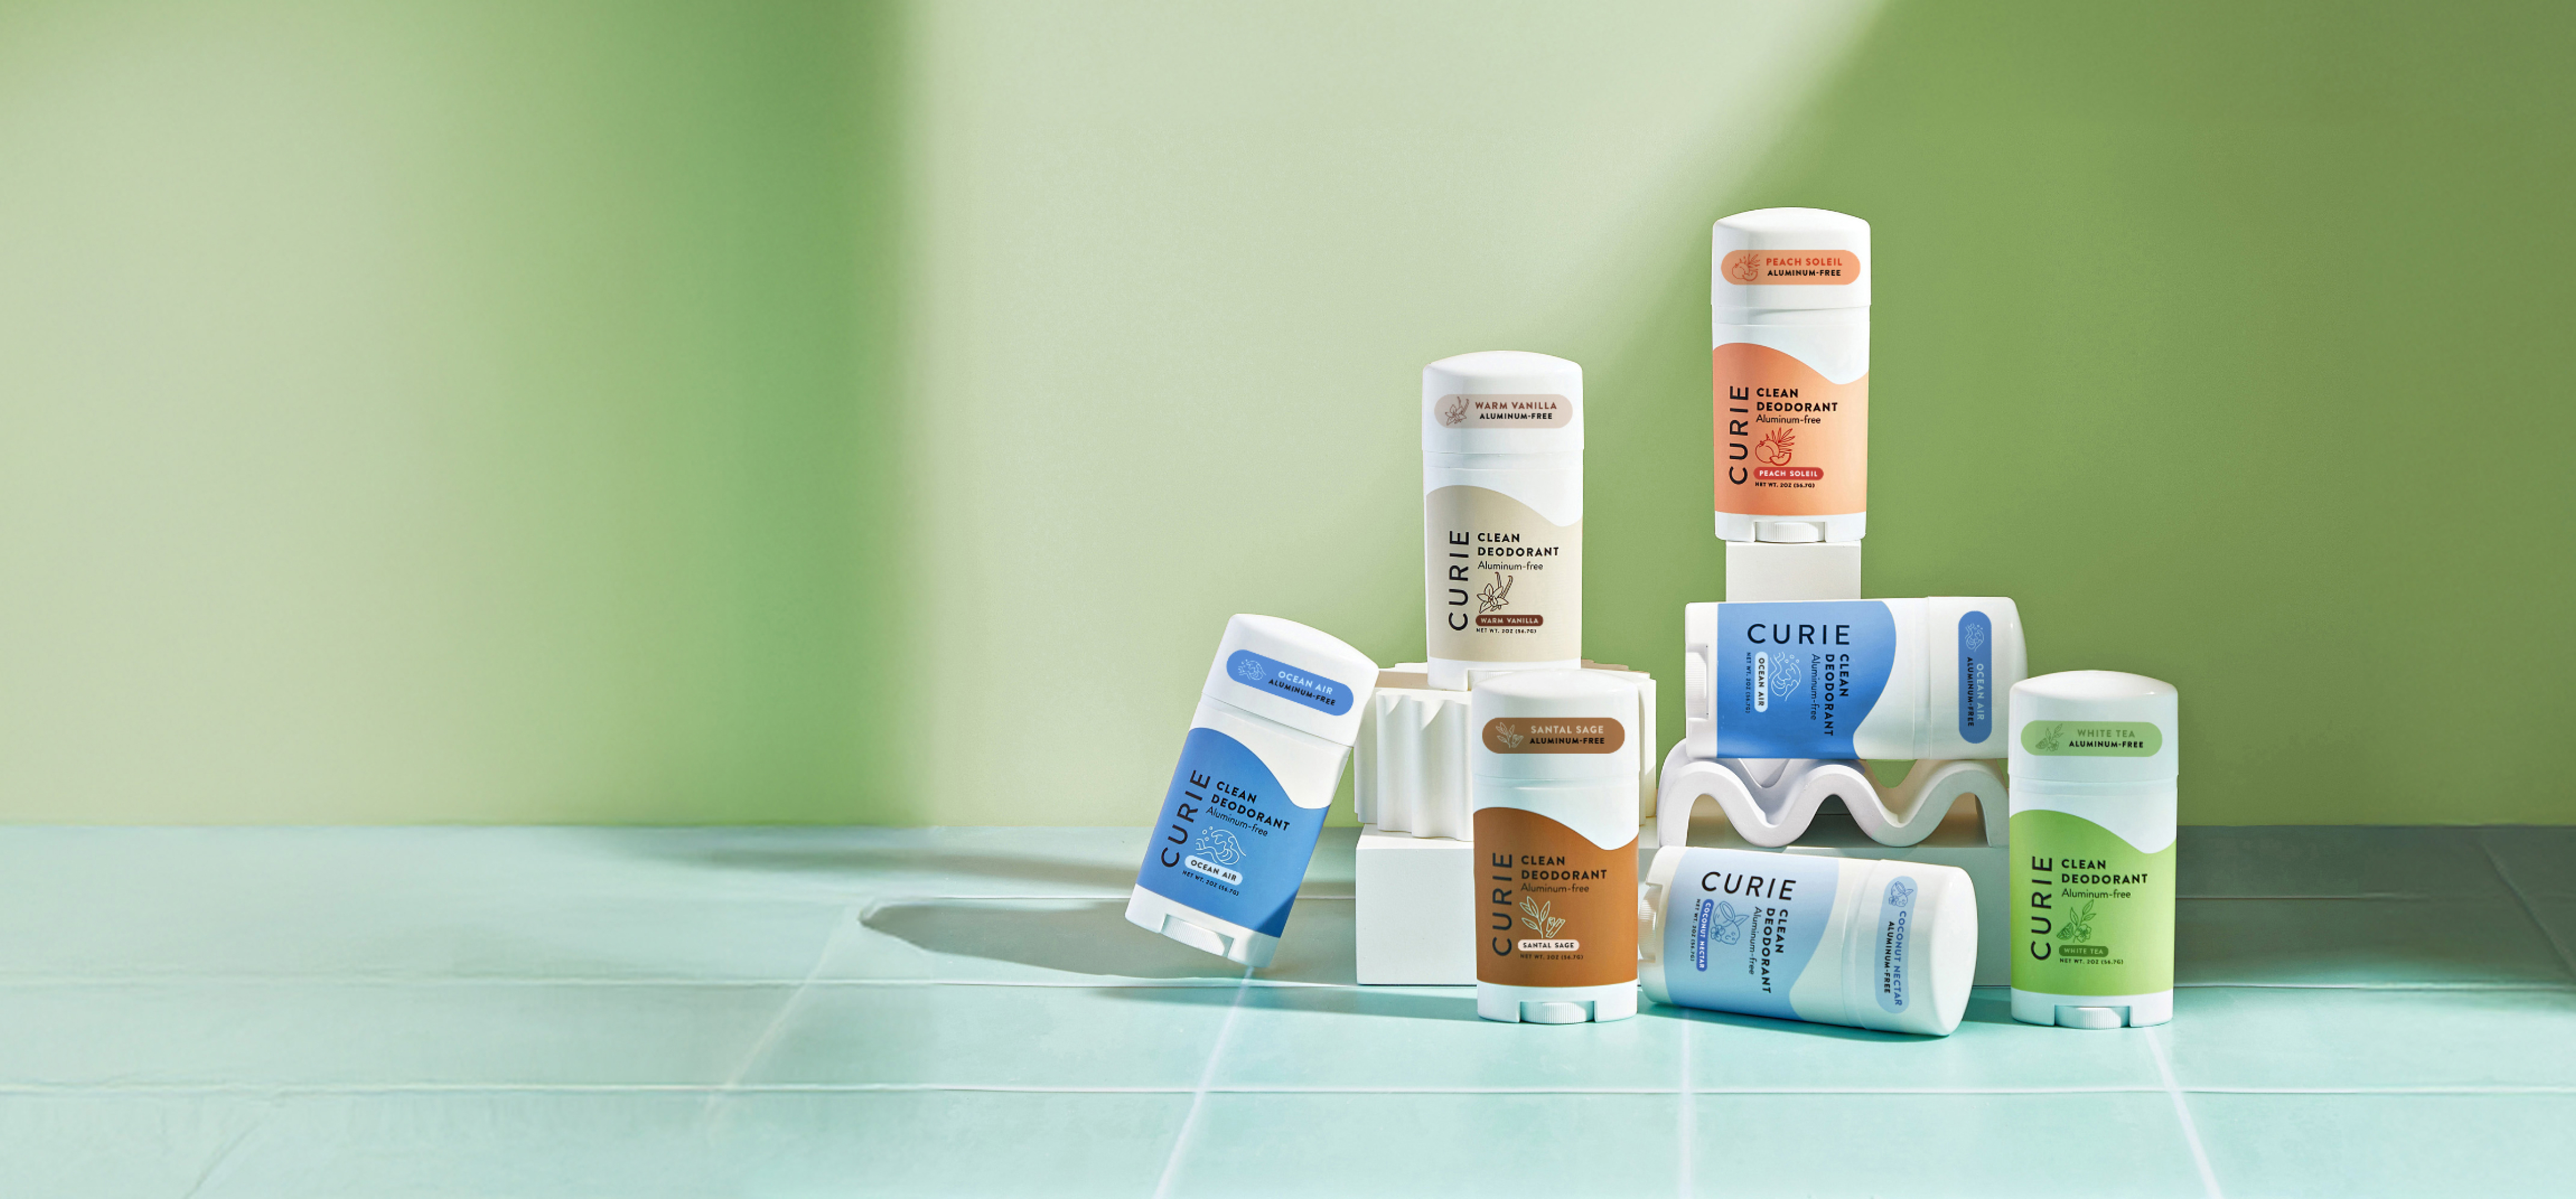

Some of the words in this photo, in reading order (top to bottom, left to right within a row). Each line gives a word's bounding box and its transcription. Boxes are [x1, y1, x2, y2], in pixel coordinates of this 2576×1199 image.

[1766, 258, 1802, 266] PEACH
[1805, 258, 1843, 266] SOLEIL
[1756, 389, 1798, 398] CLEAN
[1756, 402, 1838, 412] DEODORANT
[1756, 415, 1821, 424] Aluminum-free
[1729, 386, 1749, 484] CURIE
[1478, 533, 1520, 542] CLEAN
[1478, 547, 1558, 556] DEODORANT
[1478, 561, 1543, 570] Aluminum-free
[1449, 531, 1469, 630] CURIE
[1747, 624, 1850, 645] CURIE
[1278, 671, 1313, 688] OCEAN
[1315, 684, 1333, 694] AIR
[1810, 654, 1820, 720] Aluminum-free
[1839, 654, 1849, 697] CLEAN
[1268, 679, 1336, 706] ALUMINUM-FREE
[1824, 654, 1834, 736] DEODORANT
[1531, 725, 1573, 734] SANTAL
[1576, 725, 1604, 734] SAGE
[1216, 782, 1257, 803] CLEAN
[1161, 770, 1211, 867] CURIE
[1206, 807, 1268, 837] Aluminum-free
[1211, 794, 1291, 831] DEODORANT
[1190, 859, 1220, 875] OCEAN
[1222, 871, 1237, 882] AIR
[1521, 855, 1565, 865] CLEAN
[2062, 859, 2106, 869] CLEAN
[1195, 875, 1205, 883] WT.
[1521, 870, 1607, 880] DEODORANT
[1701, 872, 1796, 901] CURIE
[2062, 874, 2148, 884] DEODORANT
[1521, 883, 1590, 893] Aluminum-free
[2062, 889, 2131, 899] Aluminum-free
[1492, 854, 1512, 956] CURIE
[2031, 857, 2052, 960] CURIE
[1701, 903, 1711, 938] COCONUT
[1775, 911, 1788, 954] CLEAN
[1748, 907, 1762, 974] Aluminum-free
[1894, 911, 1906, 962] COCONUT
[1761, 908, 1774, 994] DEODORANT
[1884, 921, 1894, 993] ALUMINUM-FREE
[1893, 966, 1902, 1006] NECTAR
